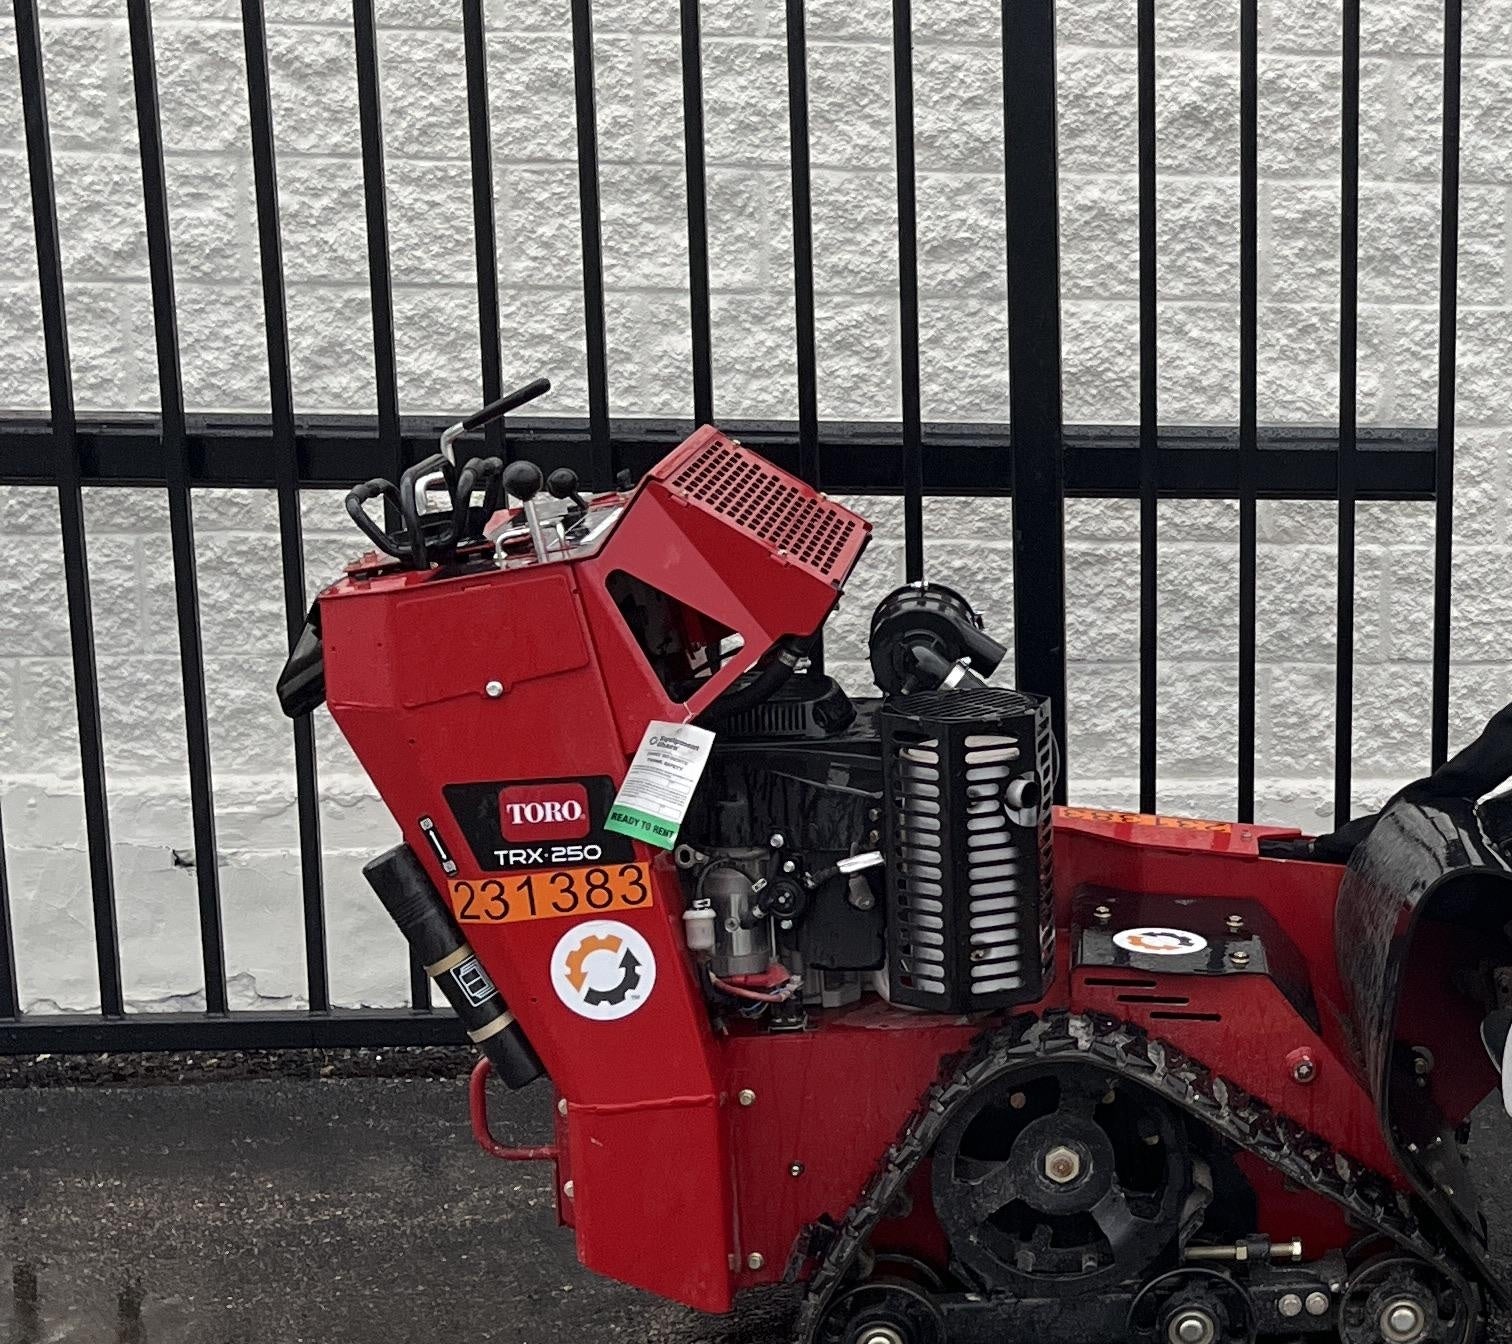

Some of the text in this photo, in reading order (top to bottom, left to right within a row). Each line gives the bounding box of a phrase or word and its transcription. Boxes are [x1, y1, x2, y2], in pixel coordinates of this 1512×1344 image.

[506, 800, 583, 825] TORO
[610, 812, 674, 838] READY TO RENT
[454, 864, 648, 921] 231383
